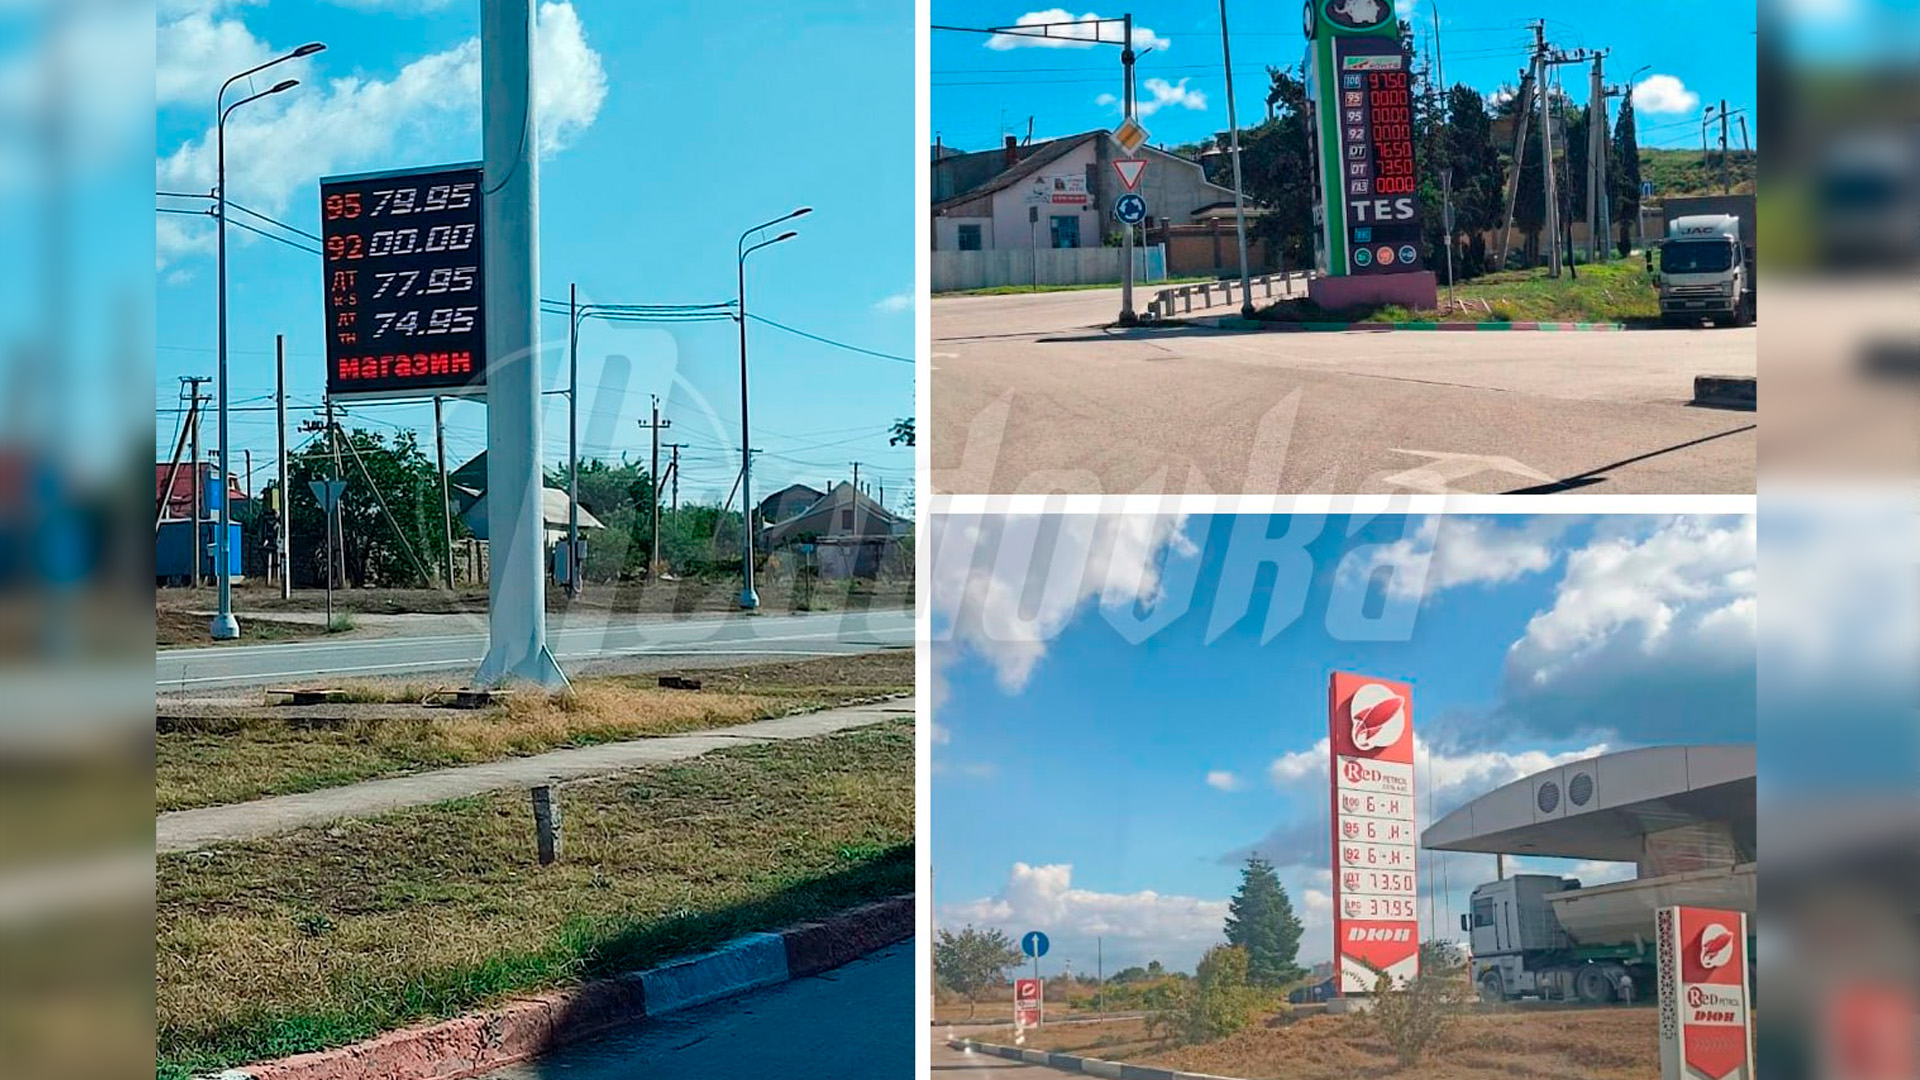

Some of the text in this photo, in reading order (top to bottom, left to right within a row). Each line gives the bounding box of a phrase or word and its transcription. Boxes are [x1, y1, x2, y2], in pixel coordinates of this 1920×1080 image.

[1348, 111, 1362, 122] 95
[1349, 129, 1364, 140] 92
[326, 183, 476, 220] 95 79.95
[1350, 198, 1414, 221] TES
[1681, 227, 1714, 235] JAC
[327, 223, 476, 261] 92 00.00
[372, 266, 478, 299] 77.95
[371, 306, 479, 339] 74.95
[338, 351, 472, 380] магазин
[1345, 822, 1360, 834] 95
[1346, 848, 1360, 860] 92
[1370, 873, 1412, 891] 73.50
[1370, 899, 1413, 917] 37.95
